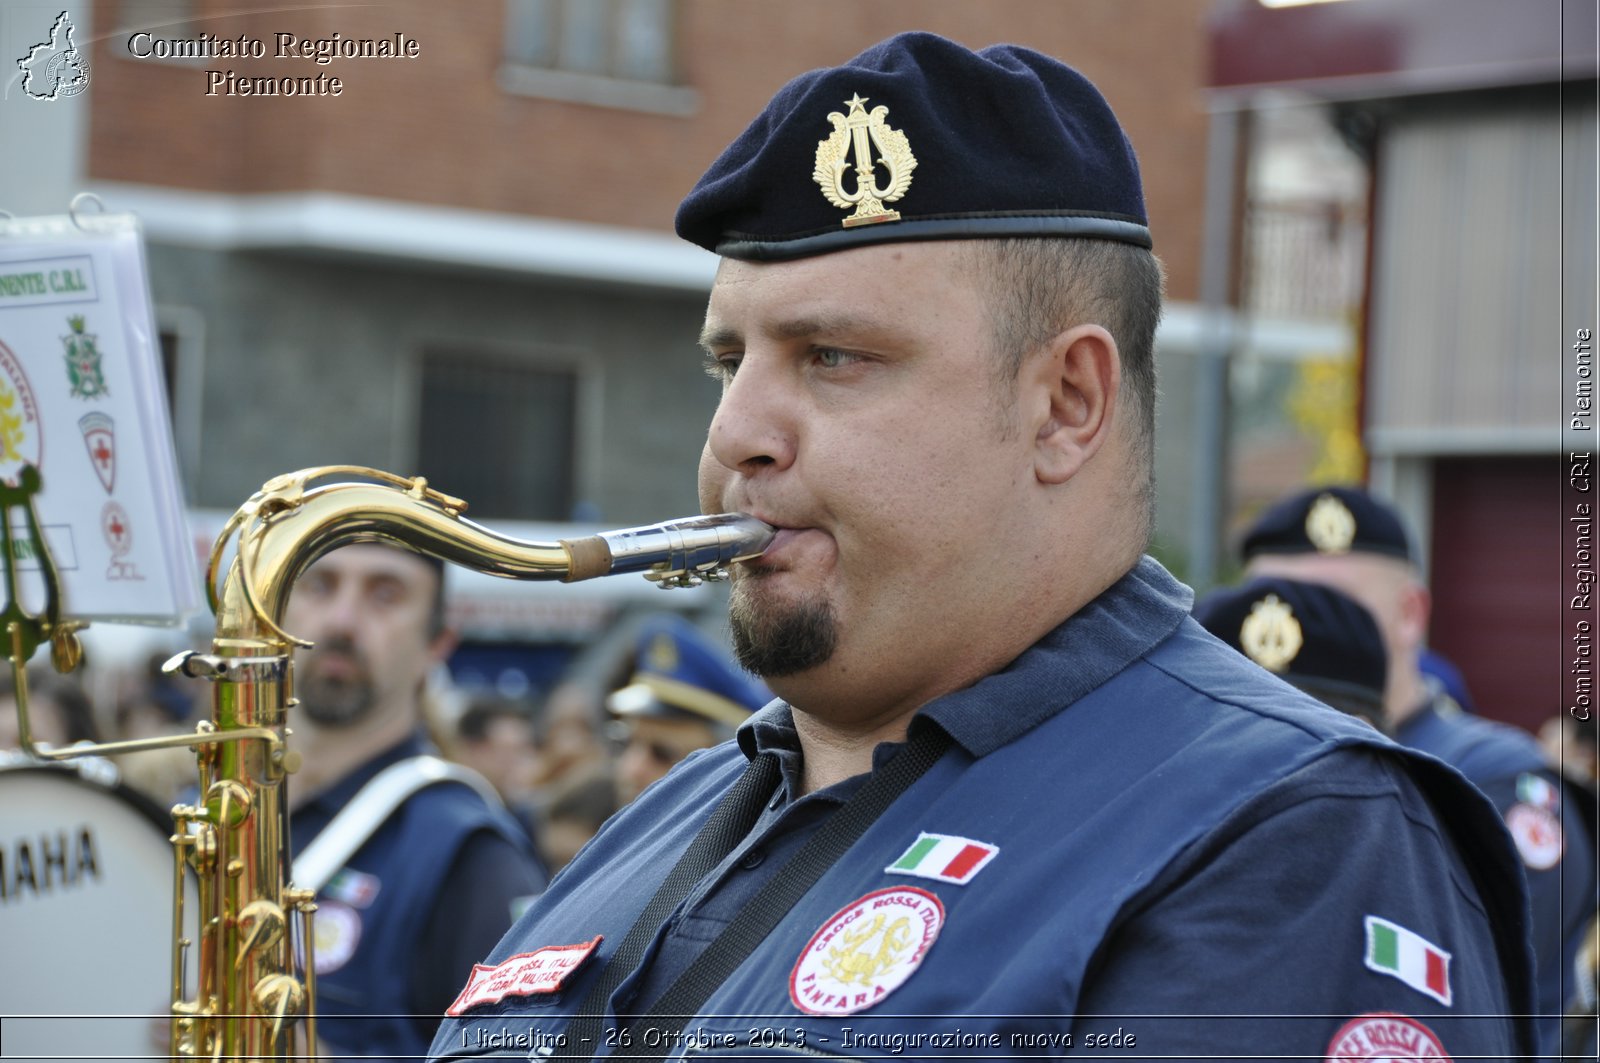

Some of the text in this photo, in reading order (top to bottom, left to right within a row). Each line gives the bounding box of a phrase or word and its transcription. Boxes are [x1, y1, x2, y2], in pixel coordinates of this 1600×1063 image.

[816, 908, 864, 952] CROCE
[873, 896, 921, 910] ROSSA
[802, 973, 885, 1008] FANFARA
